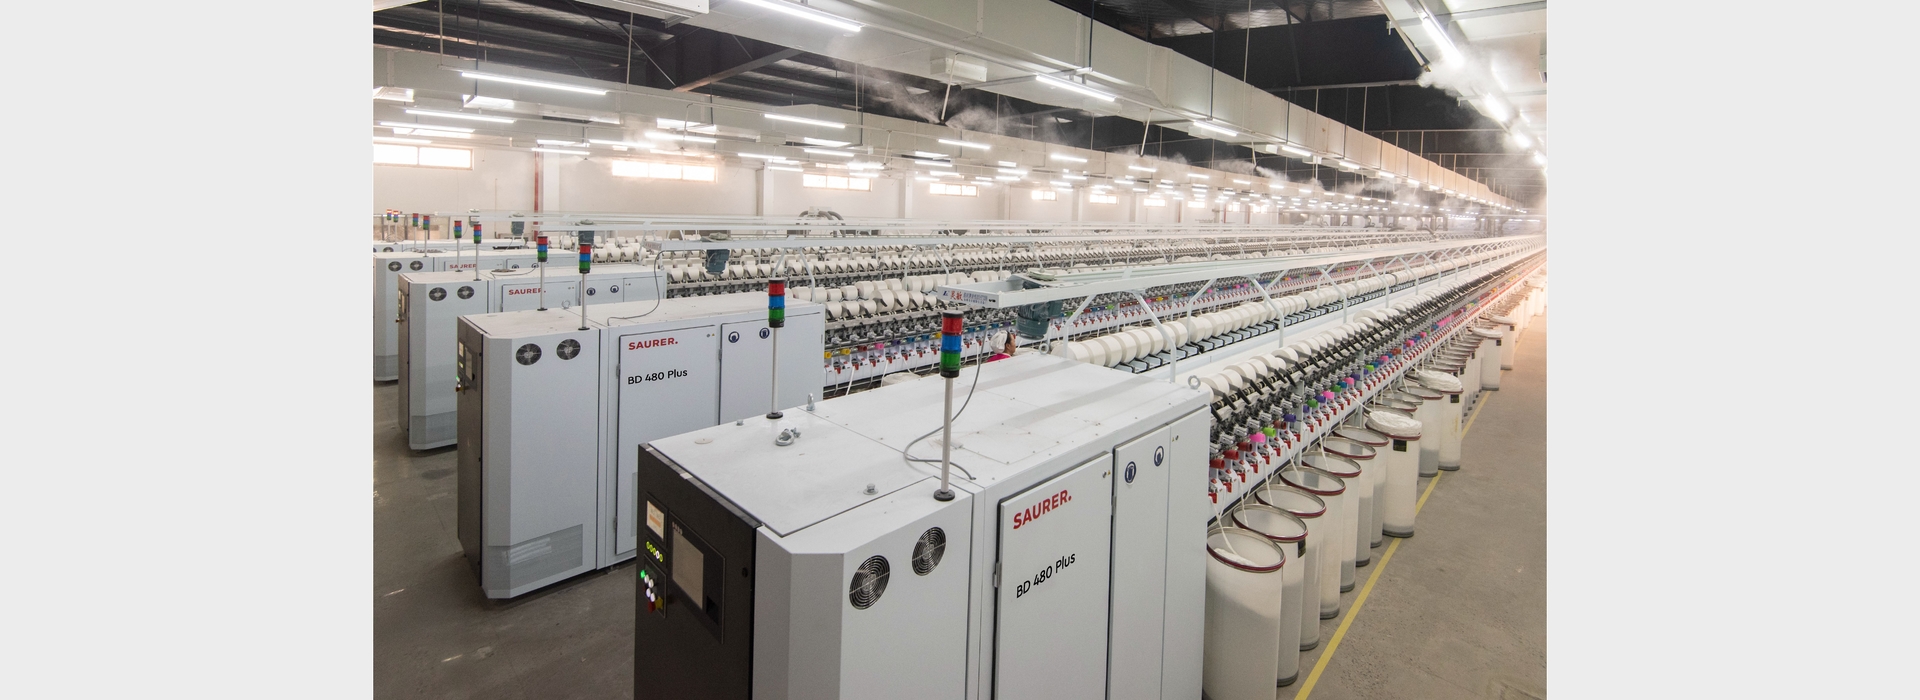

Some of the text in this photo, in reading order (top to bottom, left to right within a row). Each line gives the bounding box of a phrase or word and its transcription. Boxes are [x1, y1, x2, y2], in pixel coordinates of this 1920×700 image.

[628, 337, 678, 351] SAURER.
[627, 369, 688, 385] BD 480 Plus
[1013, 489, 1072, 530] SAURER.
[1016, 553, 1076, 599] BD 480 Plus
